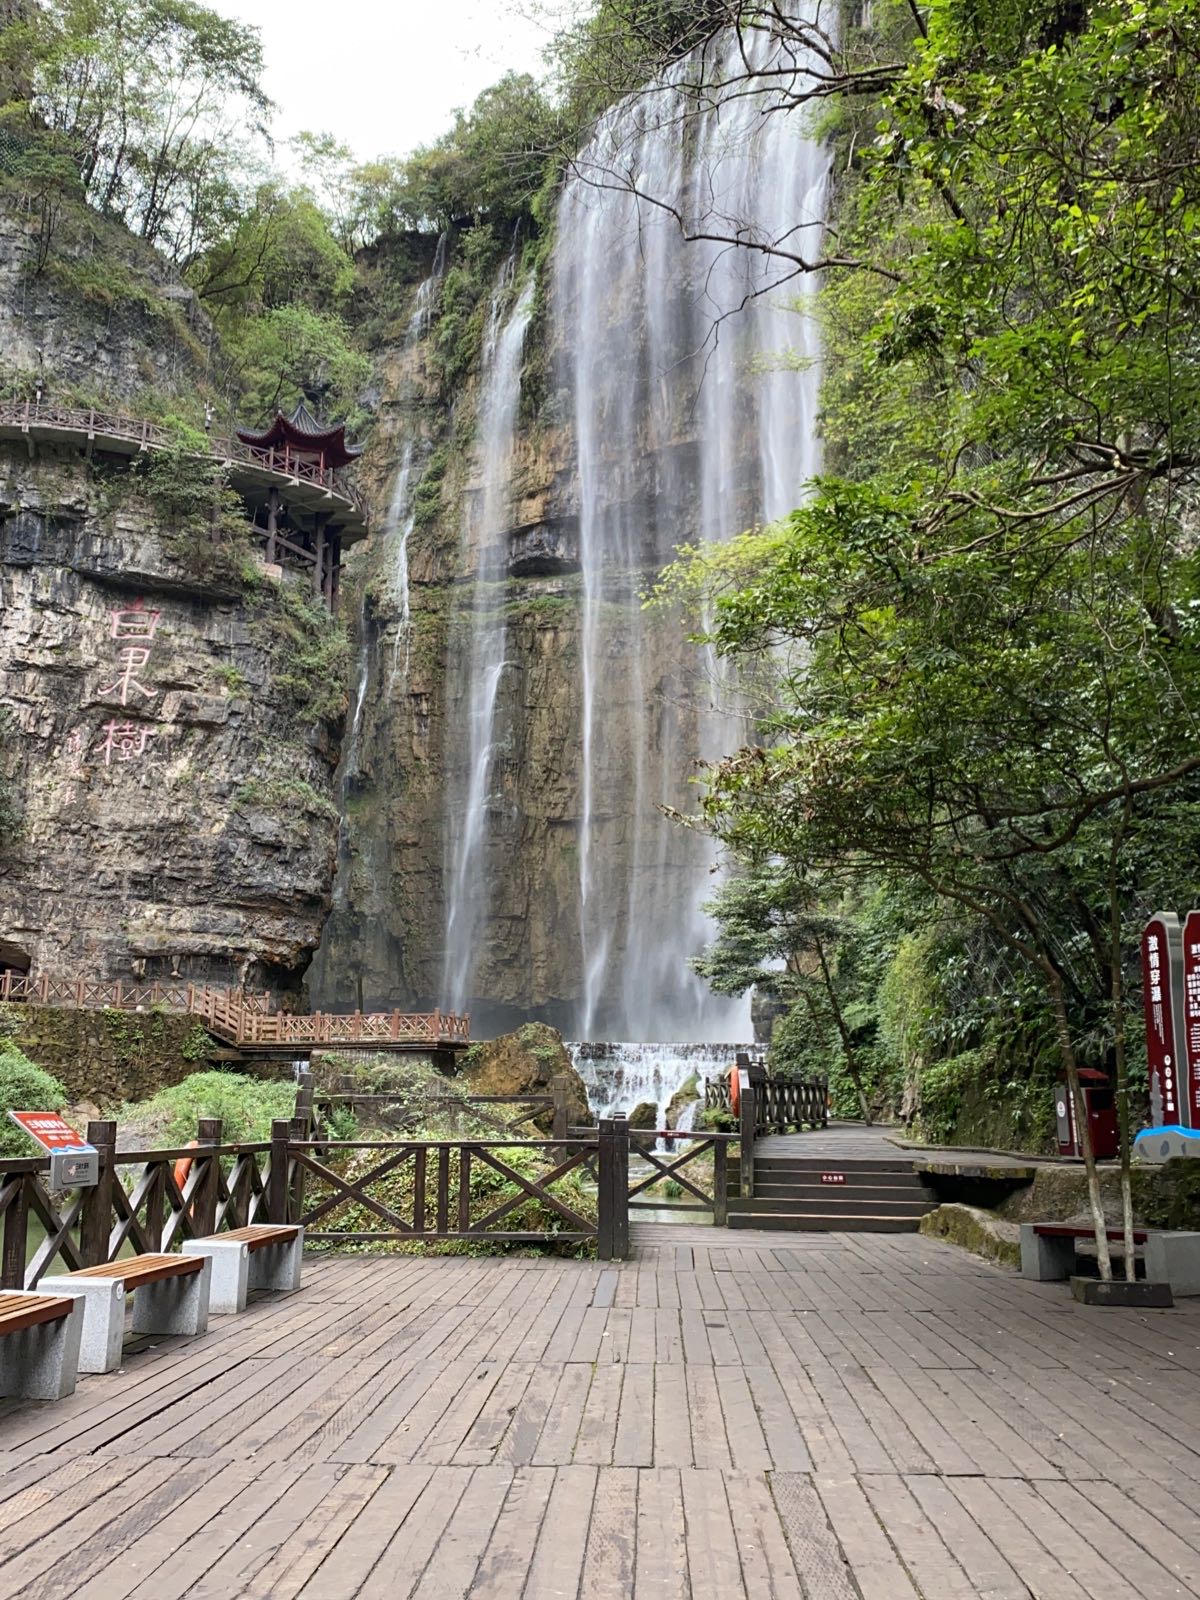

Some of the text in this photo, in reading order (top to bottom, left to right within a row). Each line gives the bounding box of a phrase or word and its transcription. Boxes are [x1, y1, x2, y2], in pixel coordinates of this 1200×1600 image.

[94, 597, 161, 766] 白果樹
[1147, 935, 1162, 1002] 激情穿瀑
